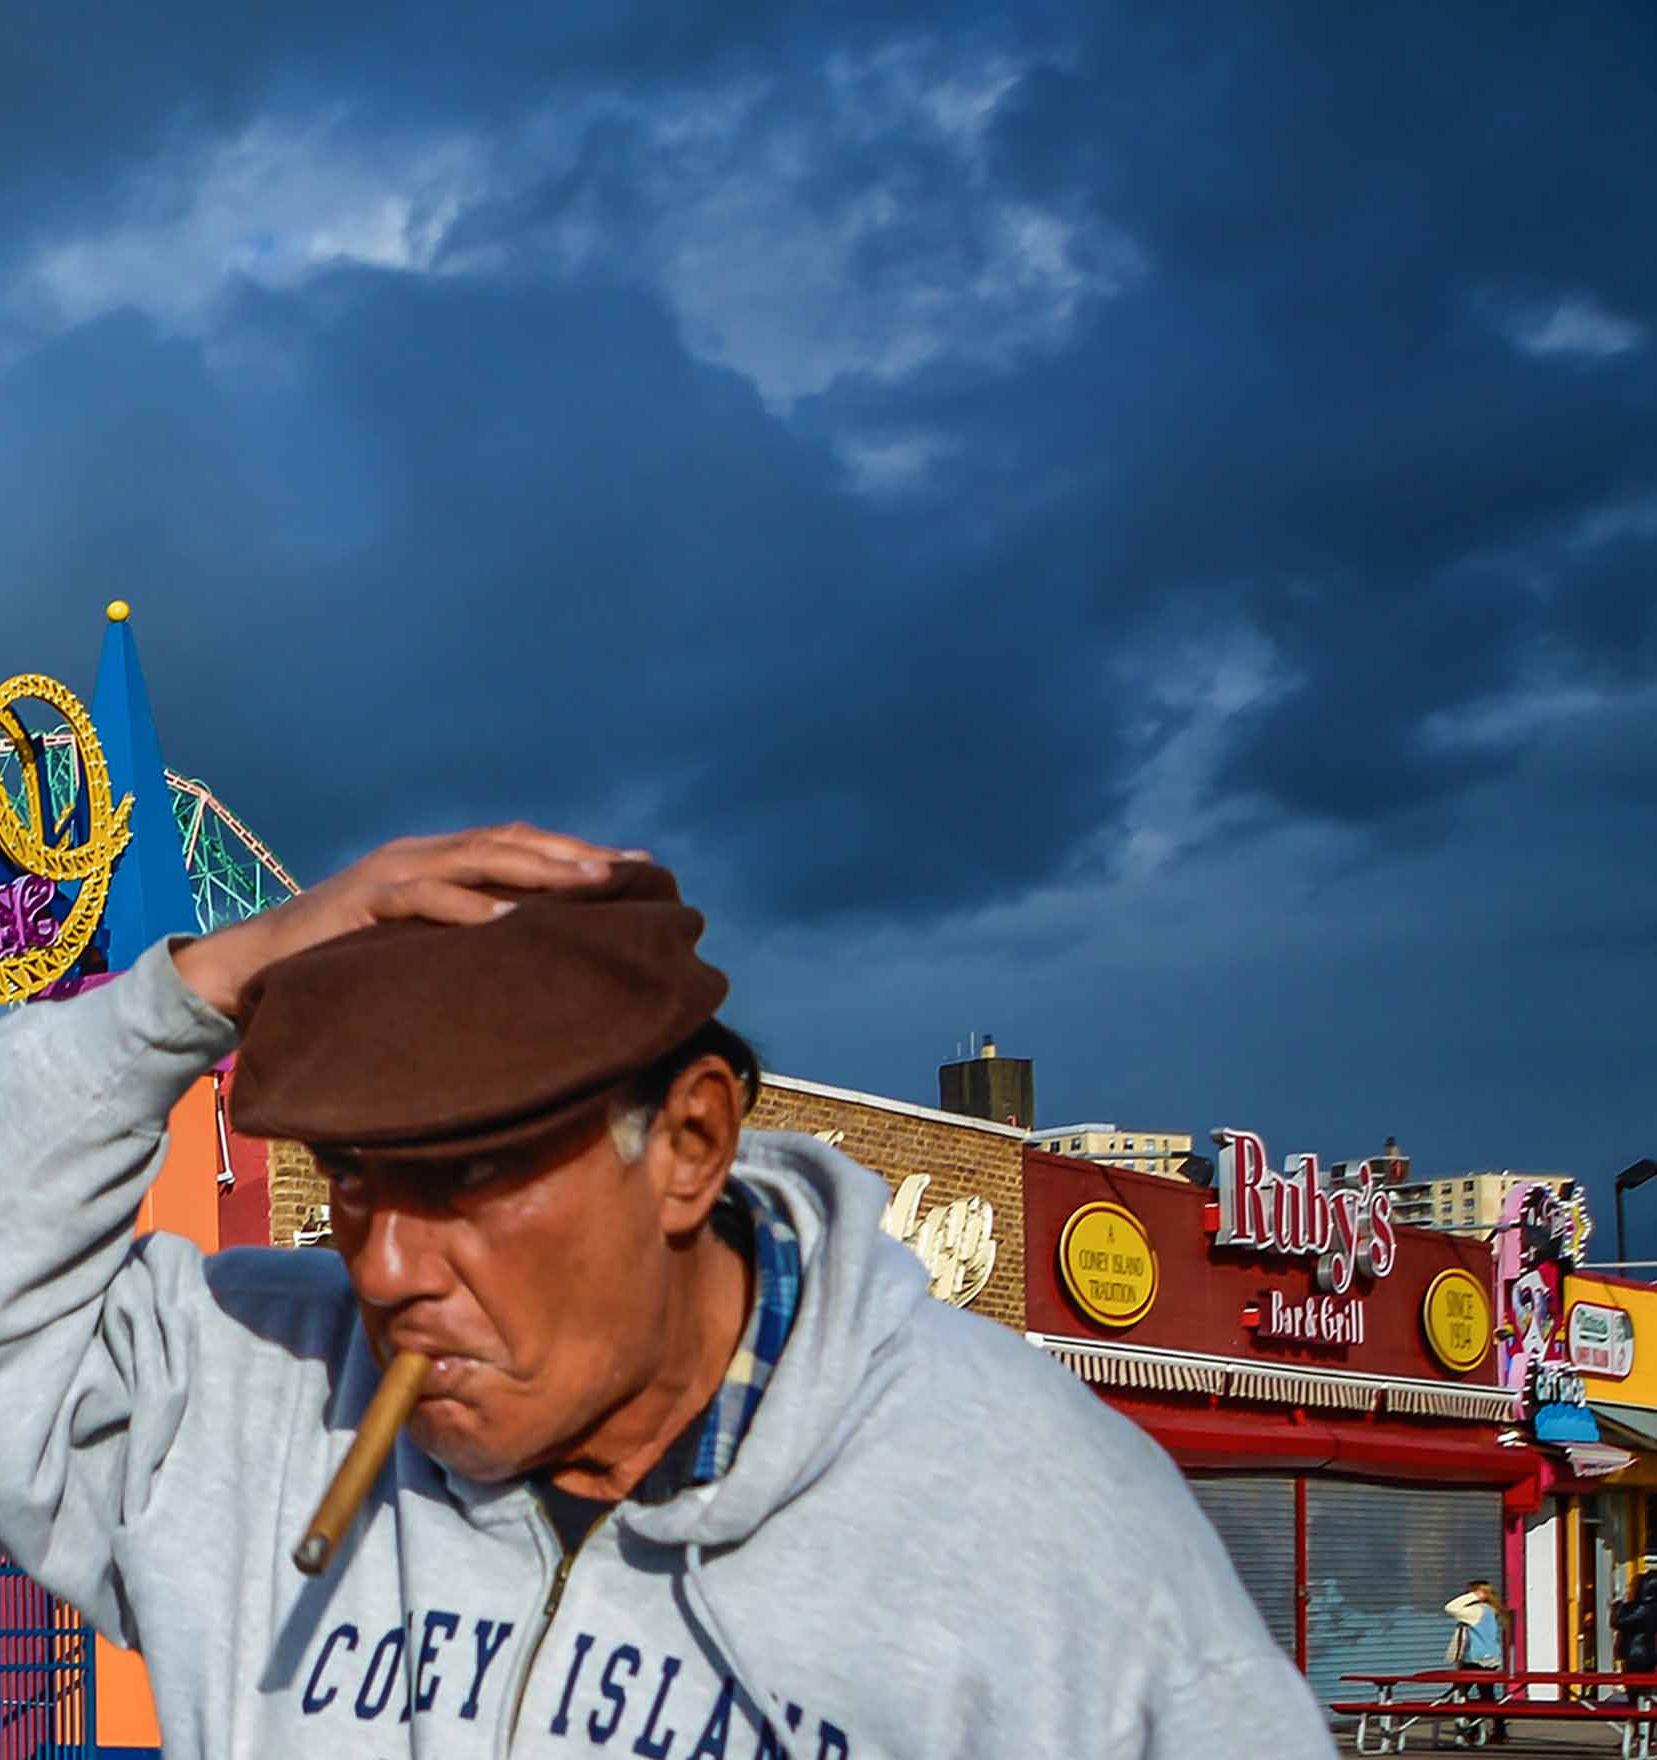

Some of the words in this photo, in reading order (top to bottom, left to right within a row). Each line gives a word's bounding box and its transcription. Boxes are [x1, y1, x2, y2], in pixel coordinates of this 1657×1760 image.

[1217, 1127, 1396, 1294] Ruby's
[1078, 1249, 1108, 1272] CONEY
[1112, 1254, 1144, 1277] ISLAND
[1088, 1279, 1137, 1304] TRADITION
